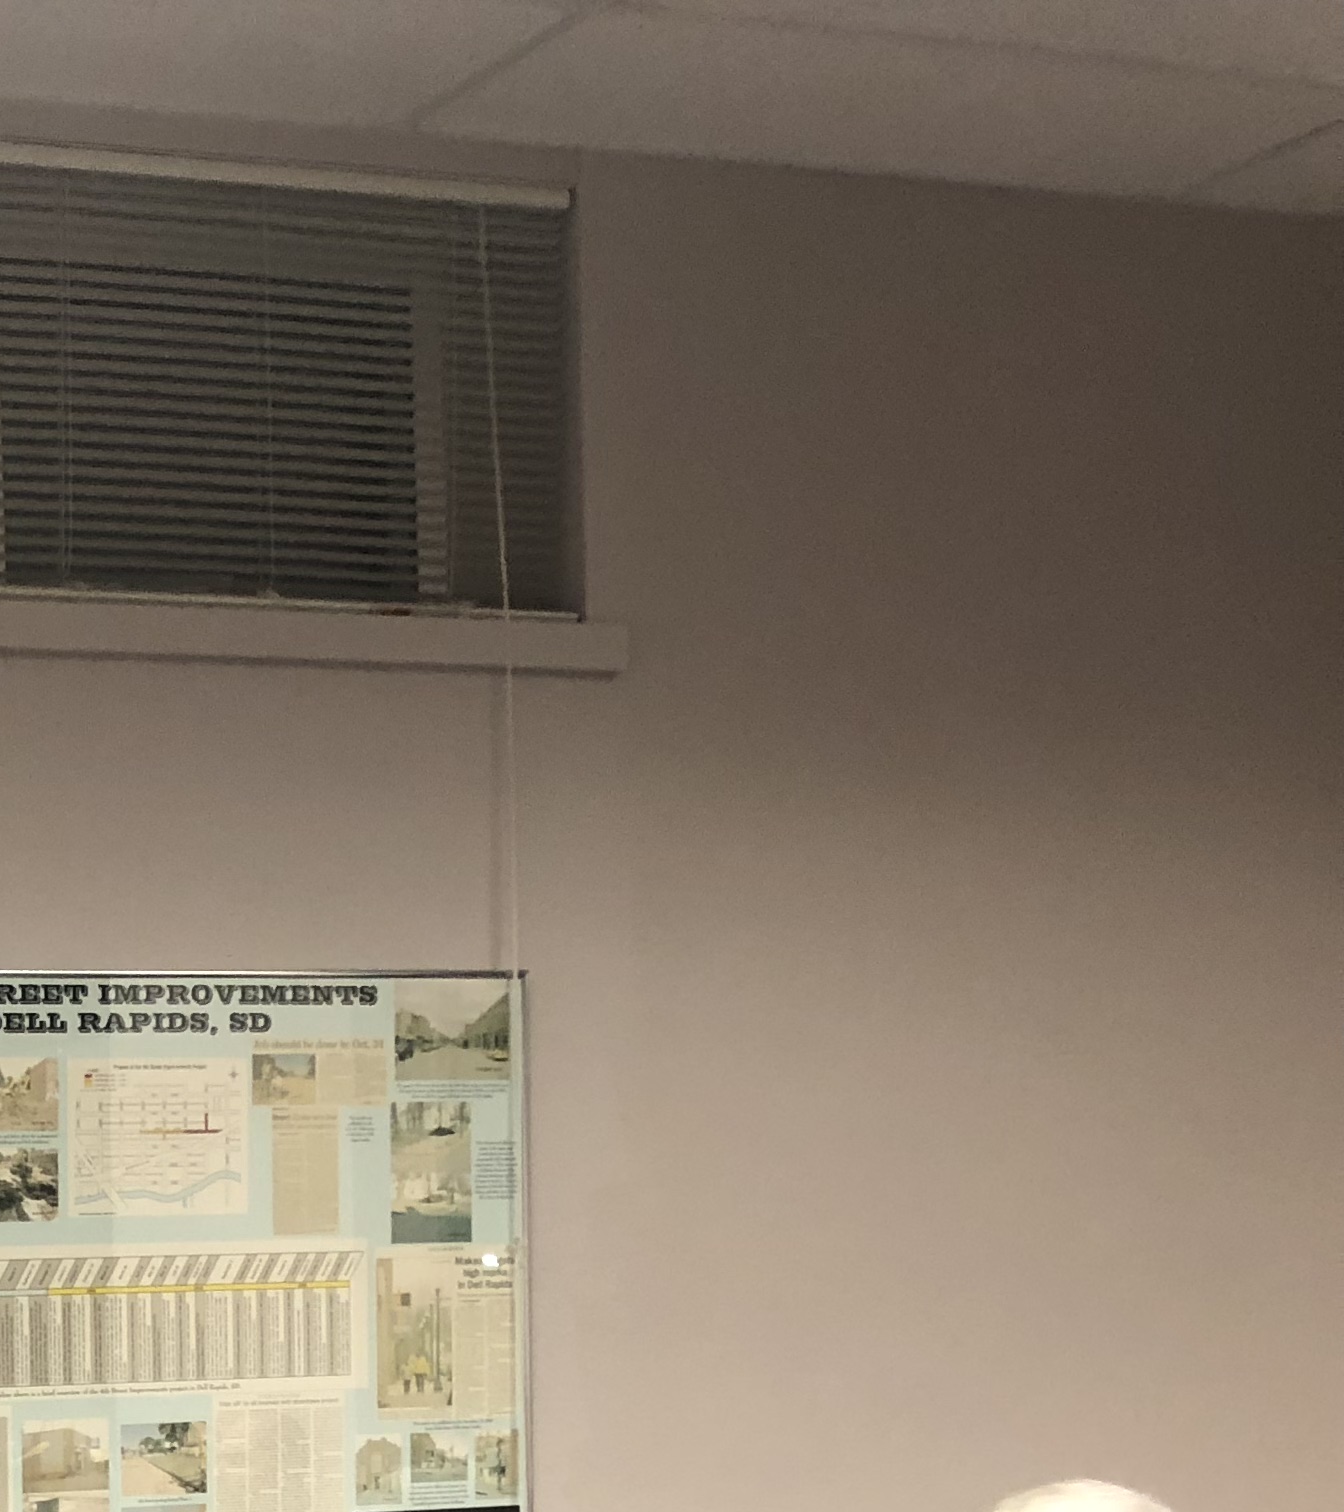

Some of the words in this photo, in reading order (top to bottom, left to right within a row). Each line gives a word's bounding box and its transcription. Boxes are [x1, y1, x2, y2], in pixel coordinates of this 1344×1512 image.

[97, 983, 379, 1006] IMPROVEMENTS
[77, 1011, 219, 1035] RAPIDS,
[228, 1011, 272, 1033] SD
